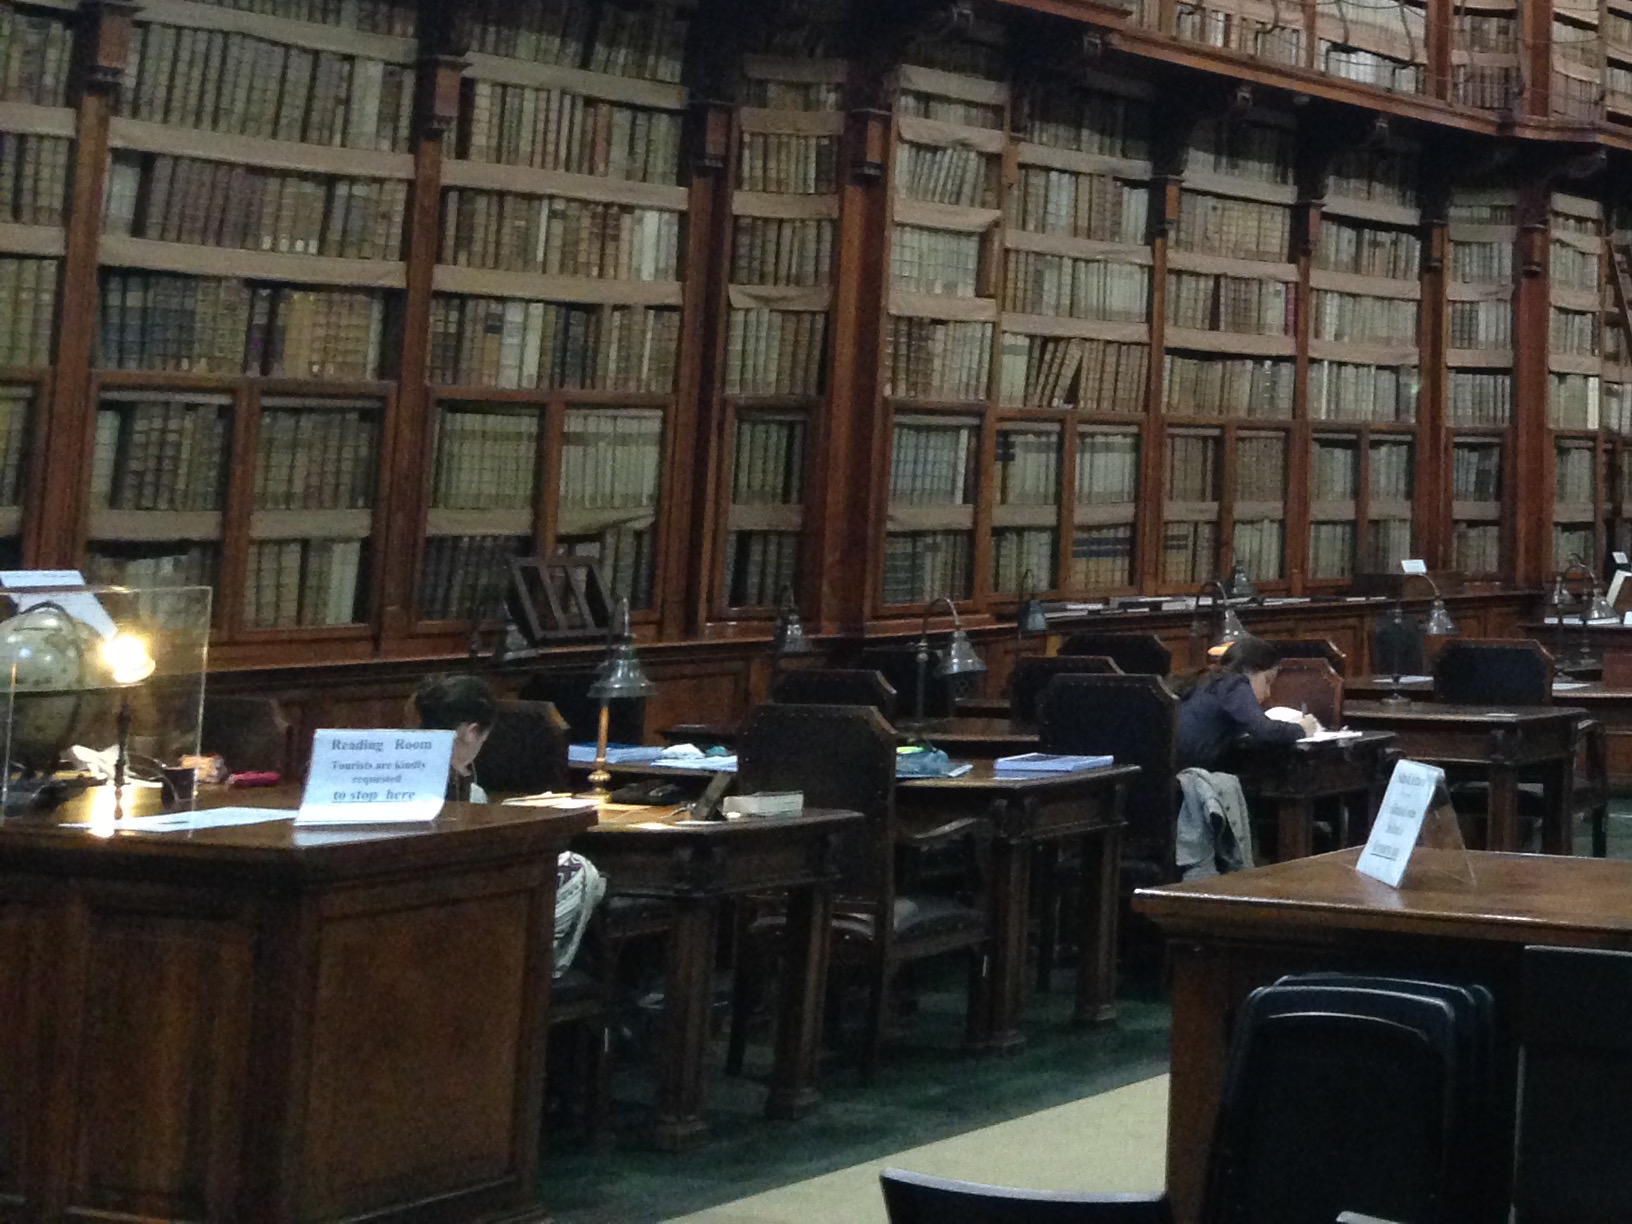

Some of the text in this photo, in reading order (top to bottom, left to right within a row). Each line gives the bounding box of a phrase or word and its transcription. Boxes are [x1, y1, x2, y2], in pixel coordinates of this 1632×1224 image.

[332, 739, 433, 752] Reading Room
[332, 760, 426, 772] Tourists are kindly
[352, 775, 402, 786] requested
[333, 790, 416, 802] to stop here
